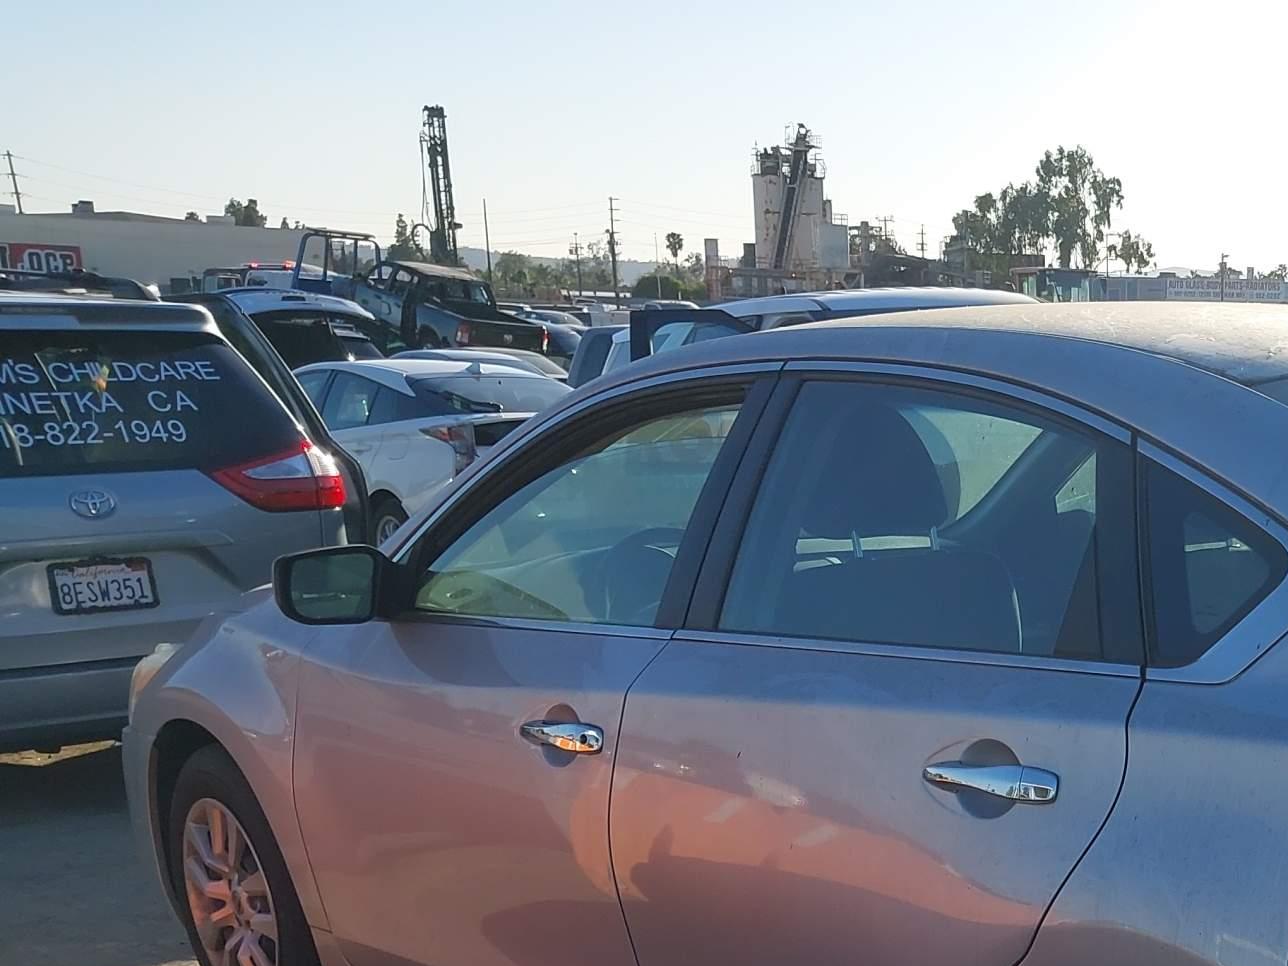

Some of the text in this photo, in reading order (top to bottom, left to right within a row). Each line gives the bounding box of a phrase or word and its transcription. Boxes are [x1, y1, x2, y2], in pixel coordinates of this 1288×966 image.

[48, 361, 220, 383] CHILDCARE
[147, 390, 198, 412] CA
[60, 577, 149, 605] 8ESW351
